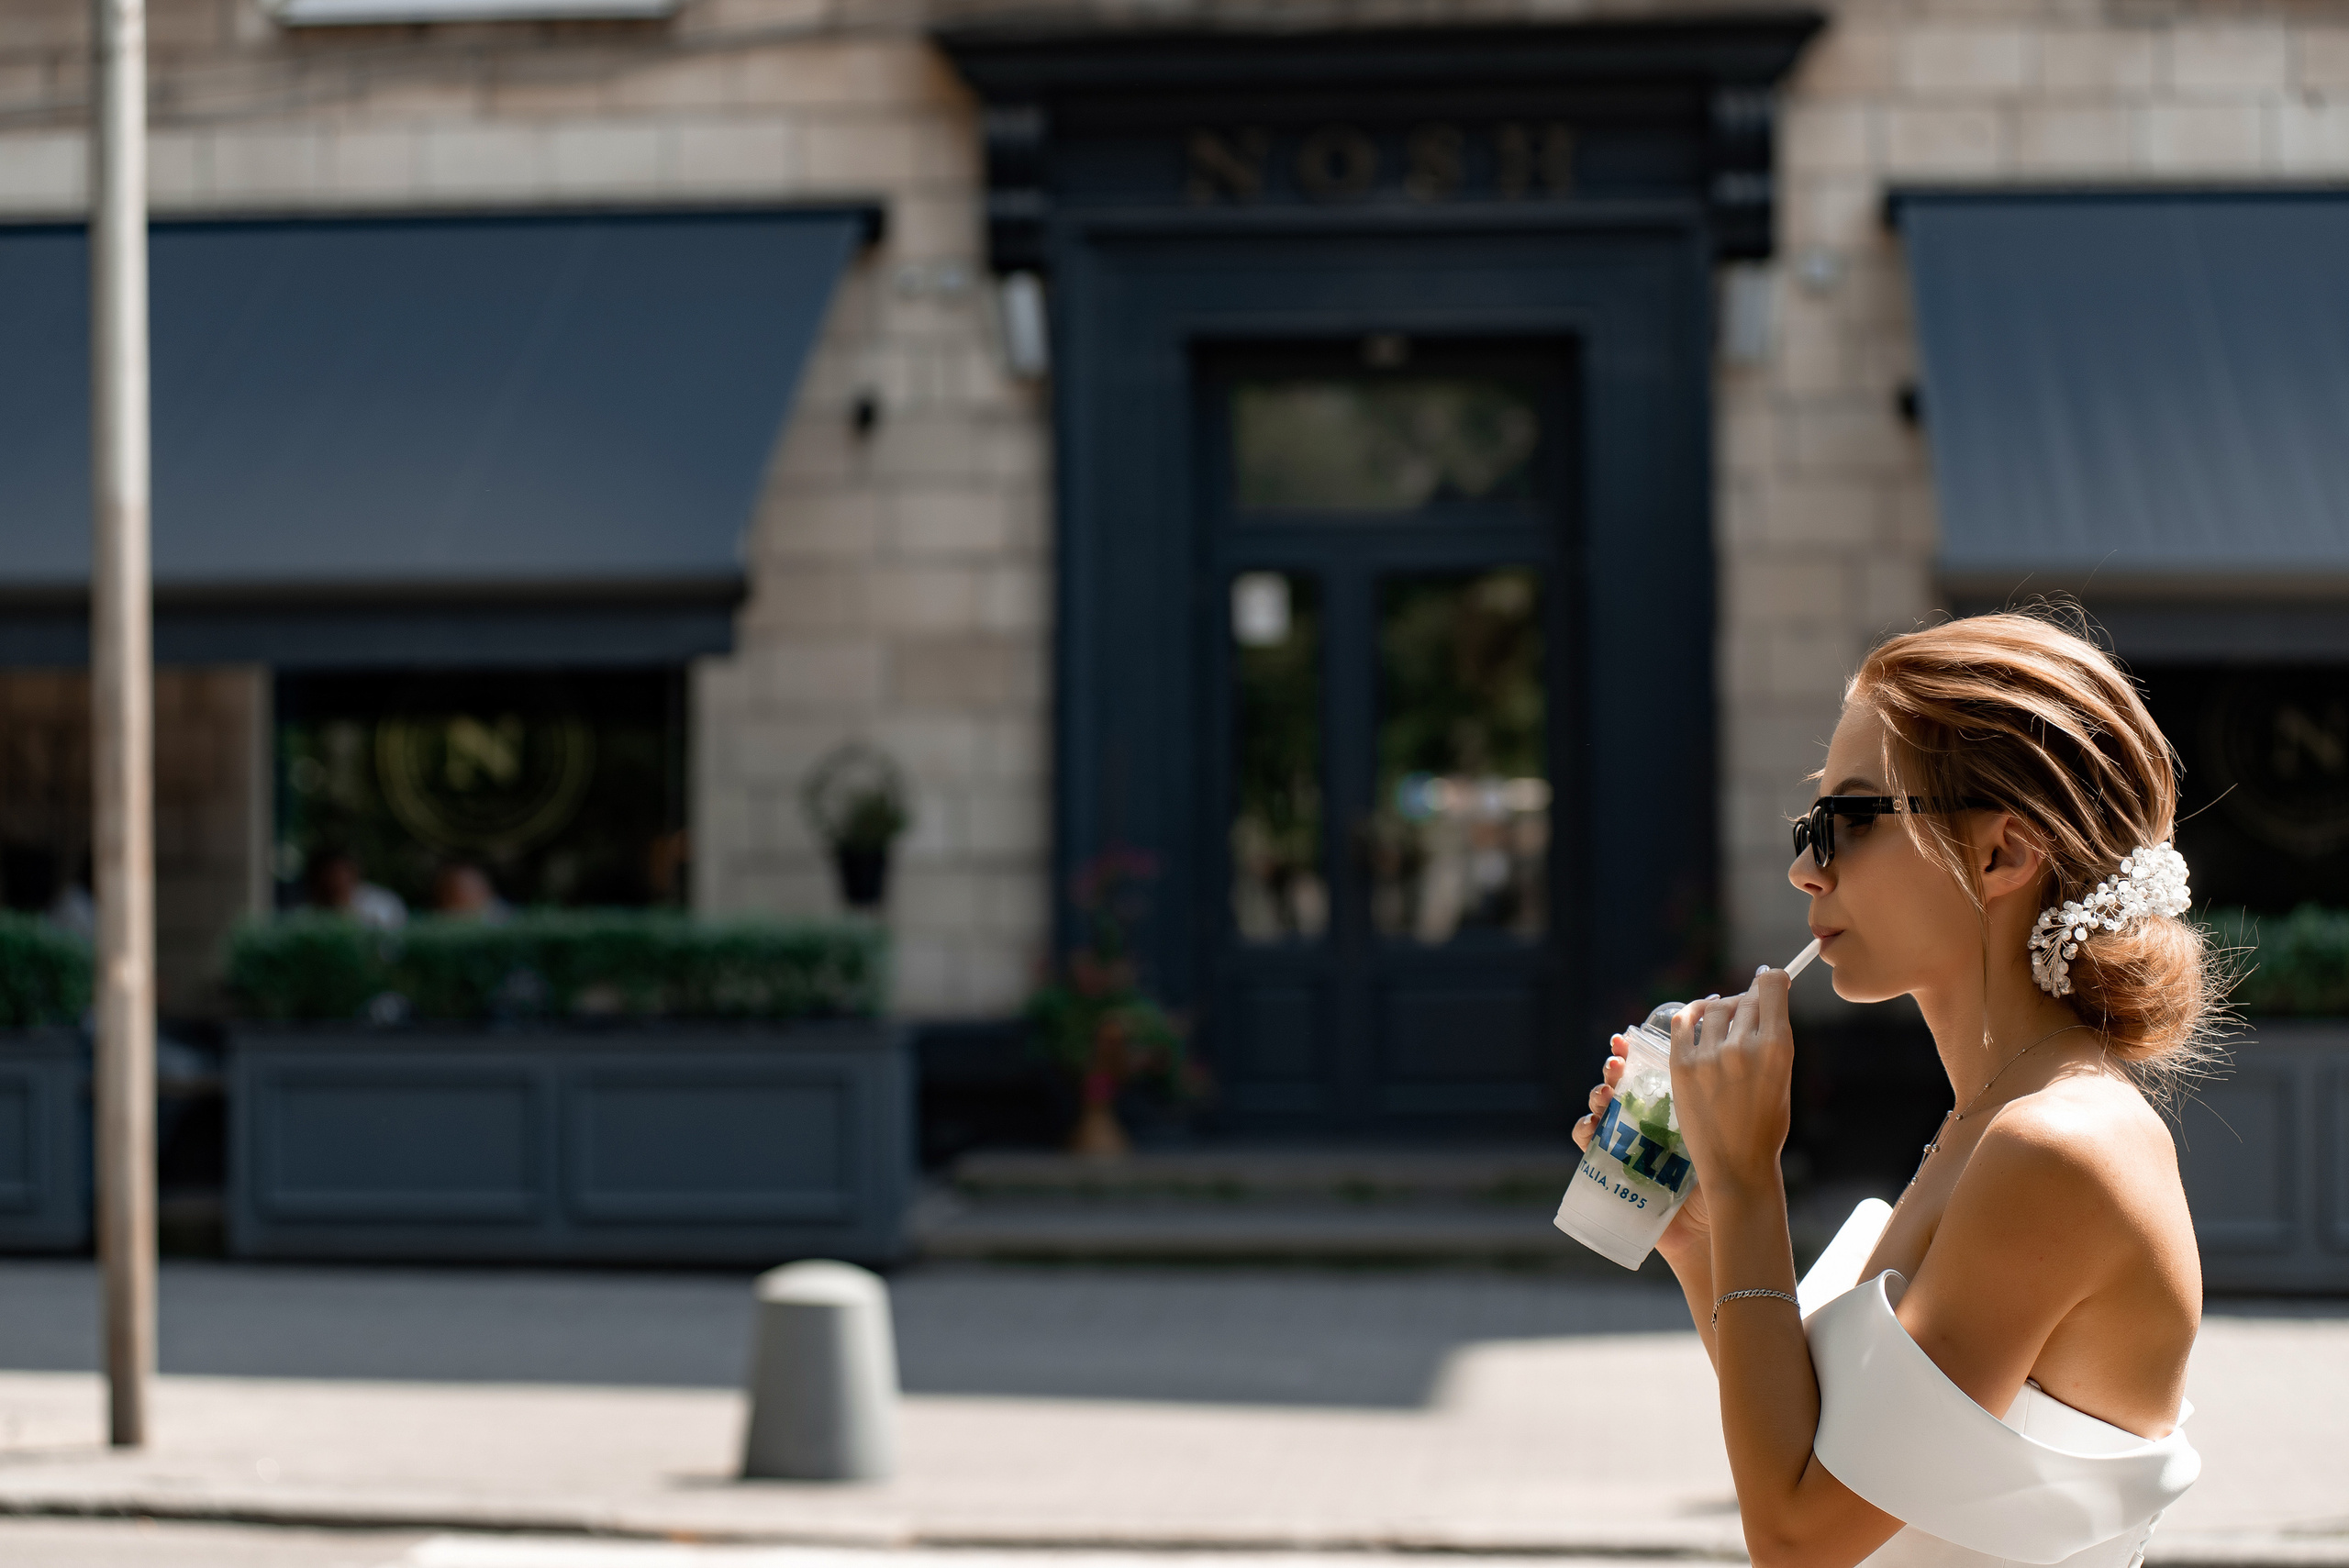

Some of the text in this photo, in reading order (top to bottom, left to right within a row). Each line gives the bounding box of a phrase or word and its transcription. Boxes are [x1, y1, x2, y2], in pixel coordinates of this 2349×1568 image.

[1186, 123, 1576, 204] NOSH
[445, 714, 525, 789] N
[1613, 1184, 1648, 1209] 1895
